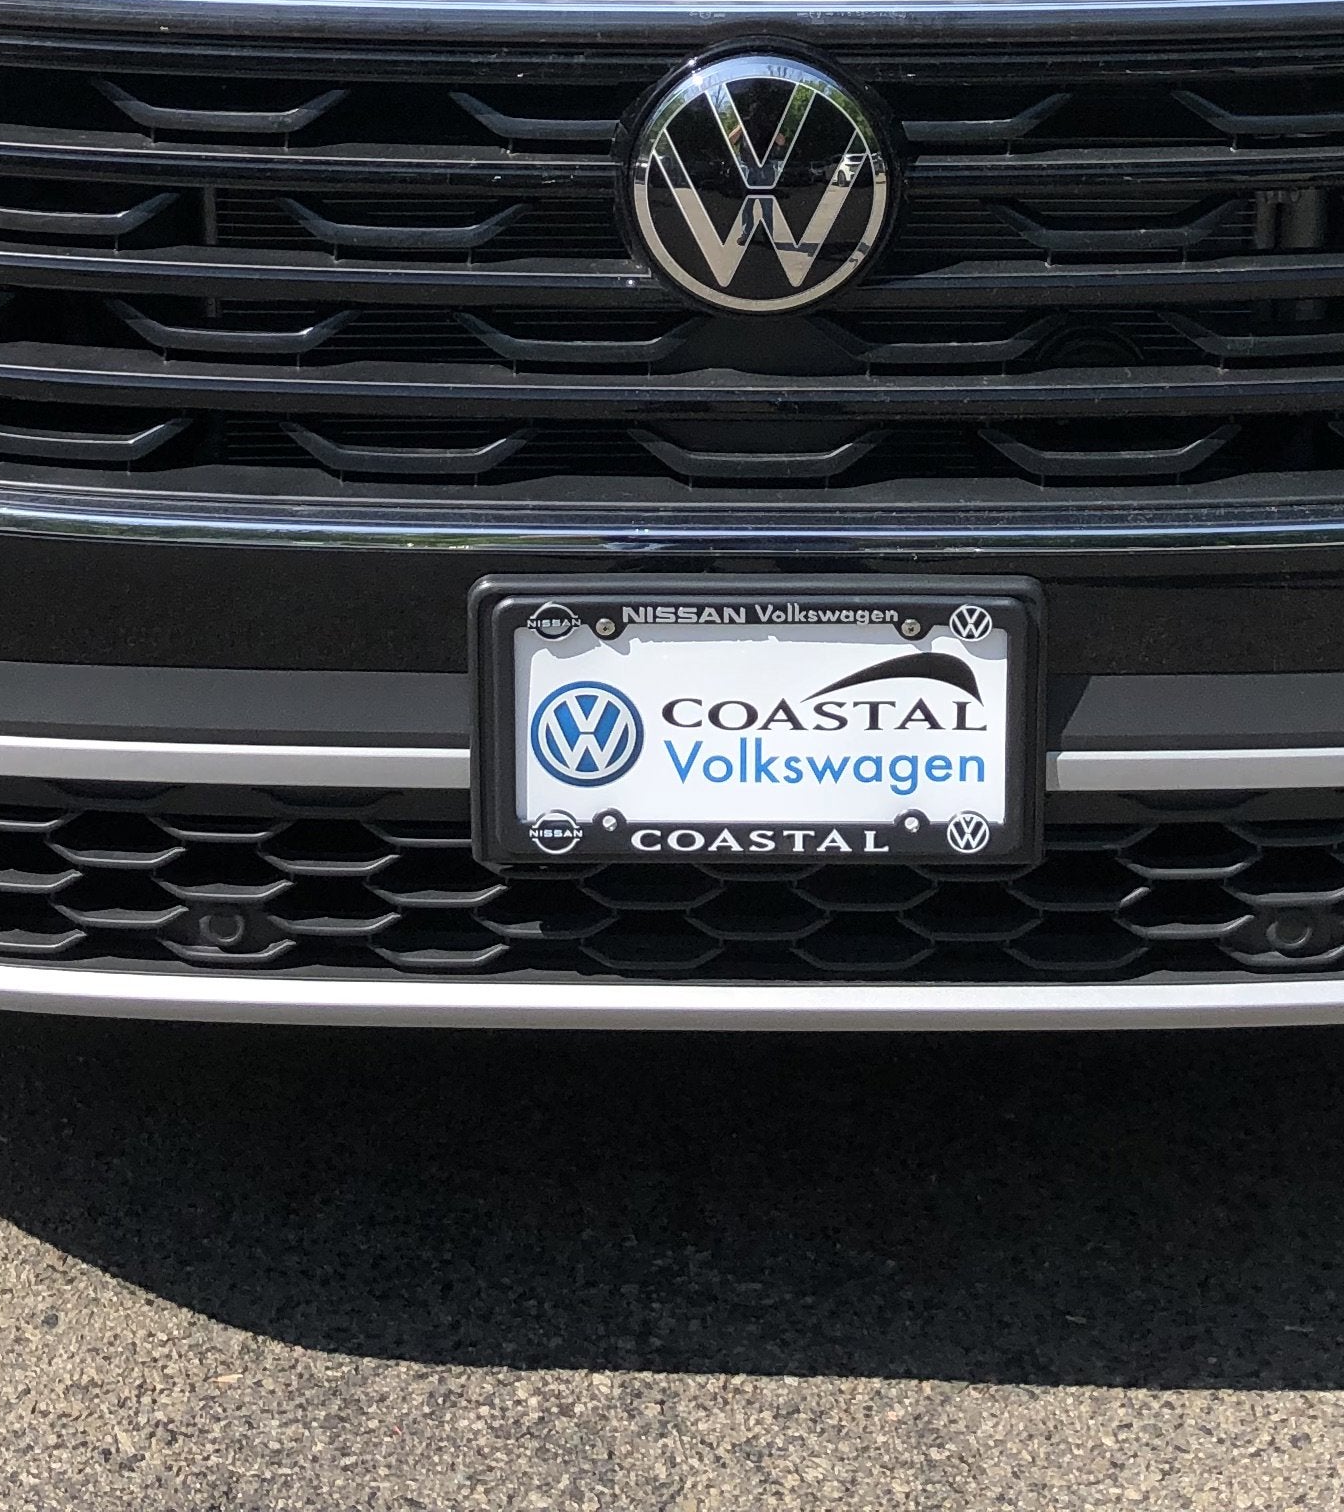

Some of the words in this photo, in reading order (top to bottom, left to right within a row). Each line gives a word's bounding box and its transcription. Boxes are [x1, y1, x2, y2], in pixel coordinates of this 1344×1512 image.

[527, 618, 581, 628] NISSAN
[622, 605, 747, 624] NISSAN
[755, 603, 899, 626] Volkswagen
[661, 696, 988, 732] COASTAL
[663, 736, 986, 796] Volkswagen
[528, 829, 583, 838] NISSAN
[630, 827, 890, 854] COASTAL
